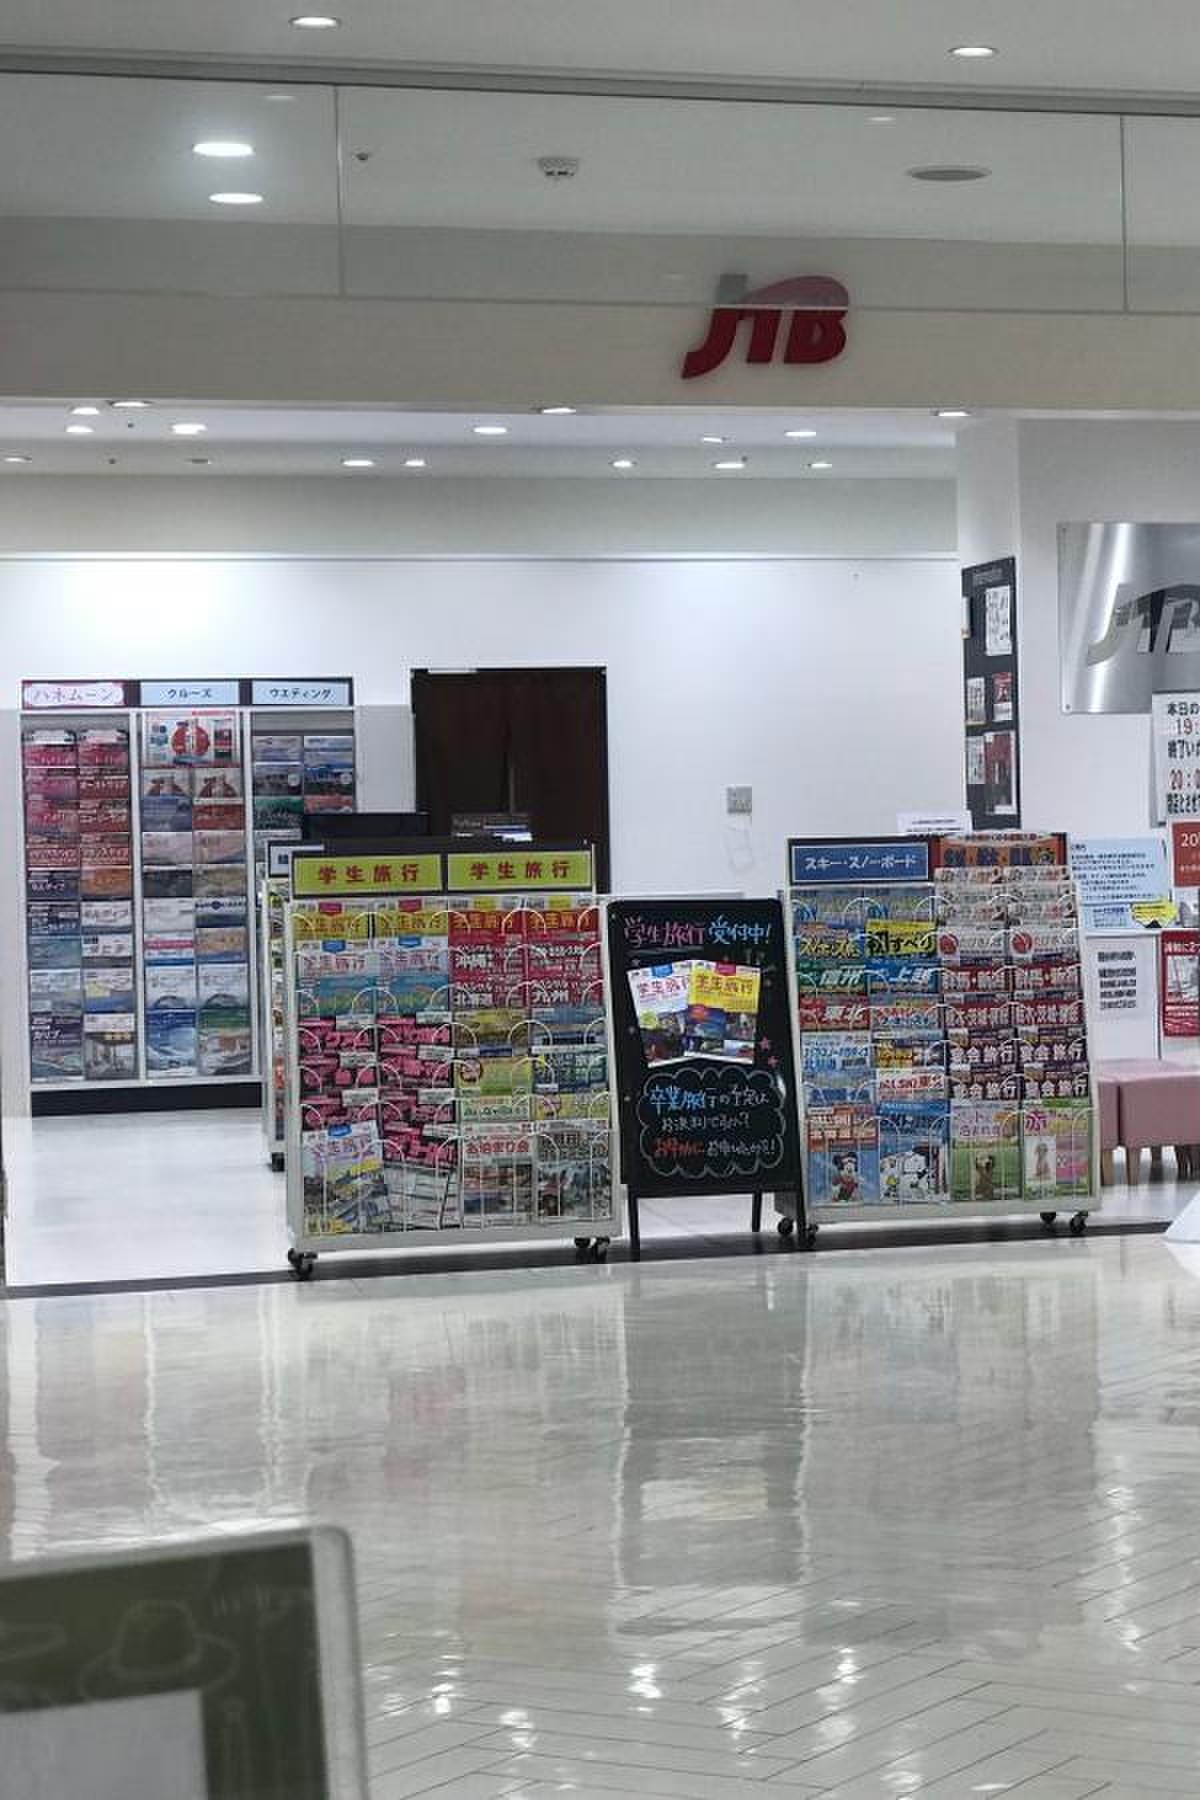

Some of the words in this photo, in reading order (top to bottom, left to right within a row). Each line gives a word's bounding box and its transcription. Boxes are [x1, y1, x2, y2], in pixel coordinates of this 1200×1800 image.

[681, 273, 849, 380] JTB
[32, 687, 114, 702] ハネムーン
[166, 687, 213, 700] クルーズ
[470, 860, 572, 880] 学生旅行
[805, 856, 917, 870] スキー・スノーボード
[318, 864, 419, 884] 学生旅行
